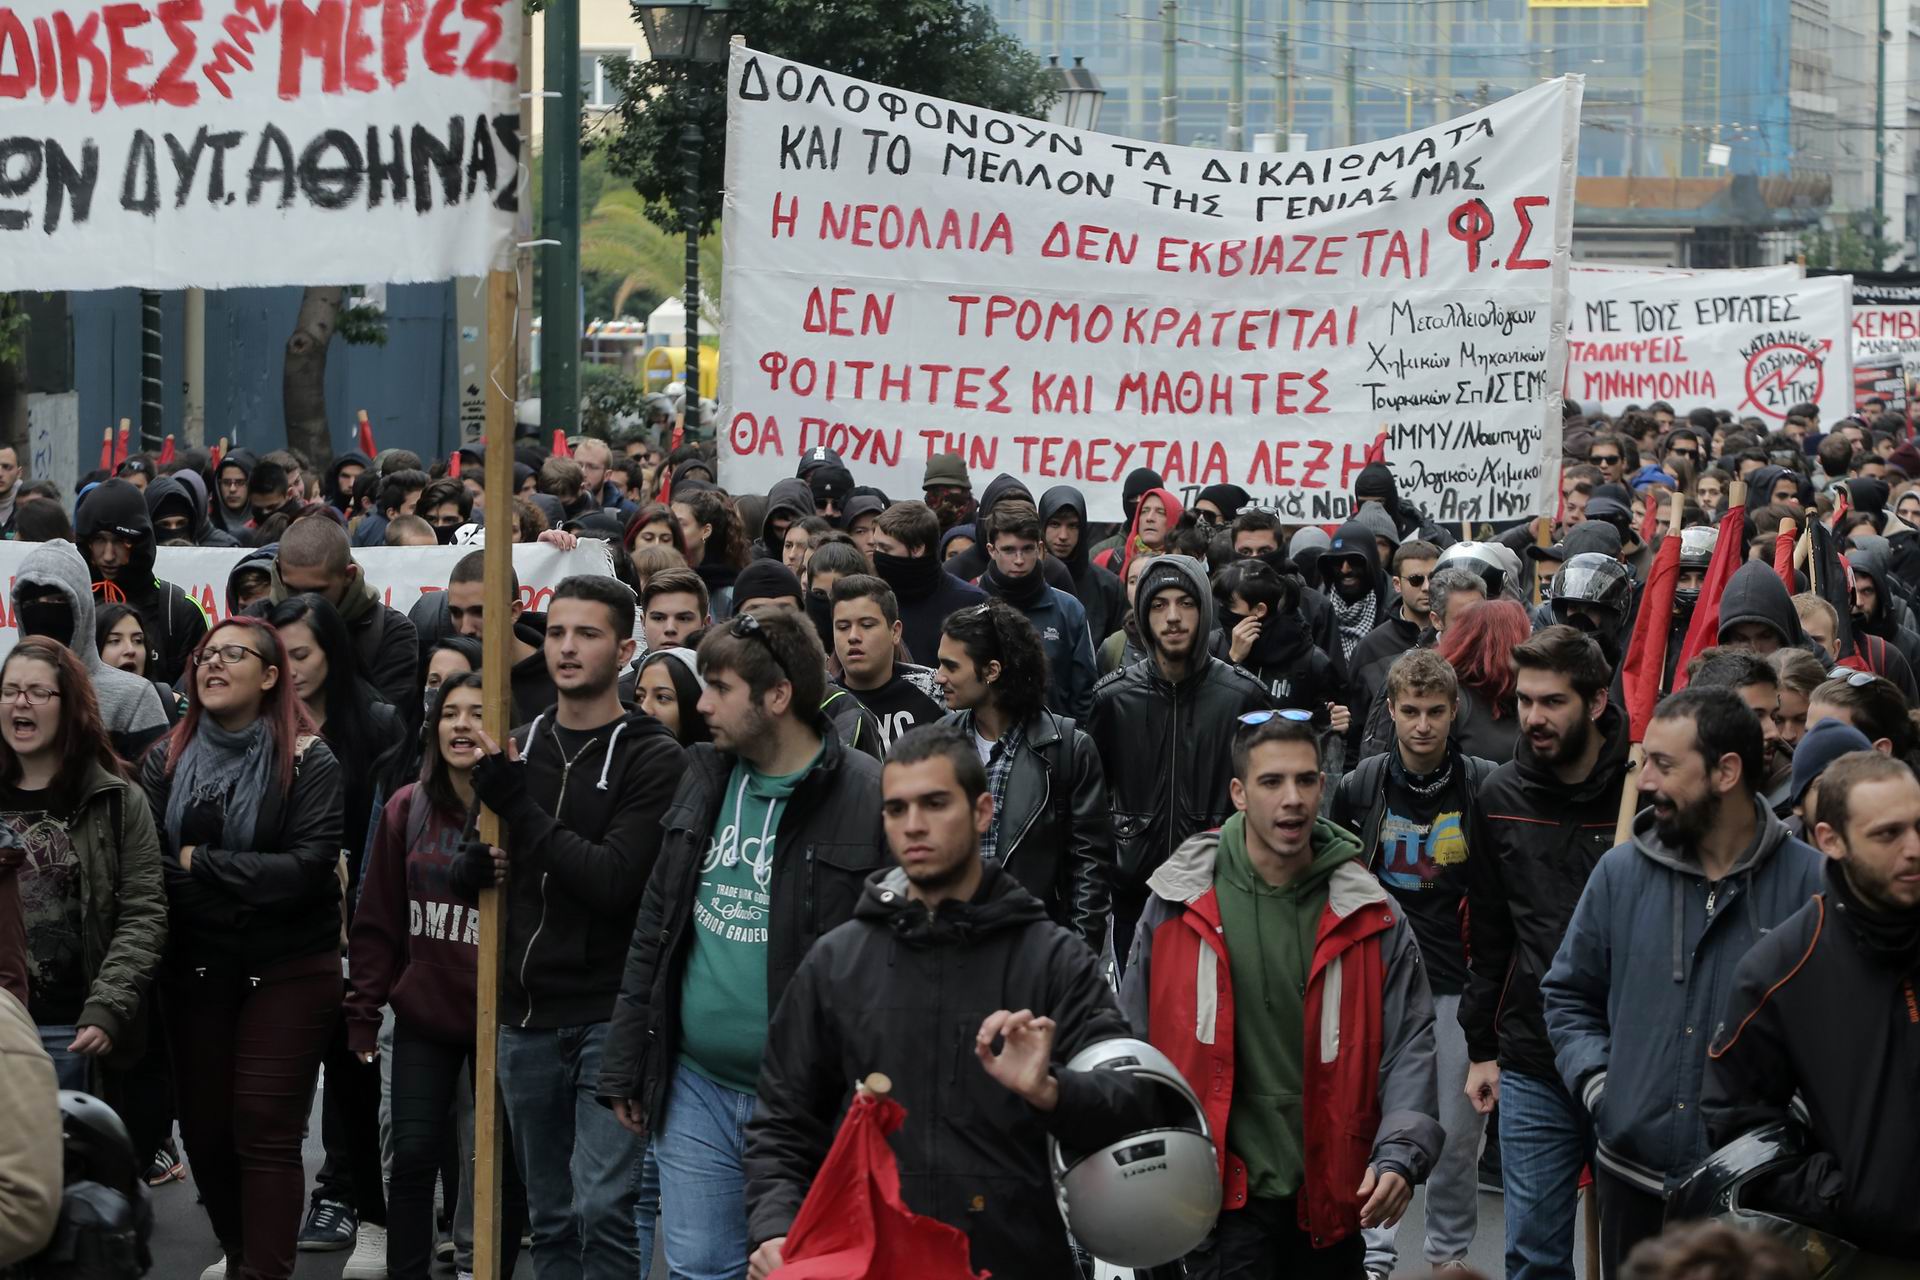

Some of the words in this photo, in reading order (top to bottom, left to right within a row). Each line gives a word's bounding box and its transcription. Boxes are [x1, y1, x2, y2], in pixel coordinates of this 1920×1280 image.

[739, 56, 1083, 156] ΔΟΛΟΦΟΝΟΥΝ
[1112, 143, 1171, 175] ΤΑ
[1201, 117, 1495, 187] ΔΙΚΑΙΩΜΑΤΑ
[780, 125, 842, 171] ΚΑΙ
[862, 128, 911, 175] ΤΟ
[942, 142, 1114, 198] ΜΕΛΛΟΝ
[1143, 181, 1224, 218] ΤΗΣ
[1256, 180, 1398, 222] ΓΕΝΙΑΣ
[1411, 156, 1485, 198] ΜΑΣ
[771, 191, 799, 239] Η
[819, 200, 1014, 255] ΝΕΟΛΑΙΑ
[1041, 221, 1138, 265] ΔΕΝ
[1156, 228, 1430, 279] ΕΚΒΙΑΖΕΤΑΙ
[802, 286, 896, 336] ΔΕΝ
[948, 294, 1359, 351] ΤΡΟΜΟΚΡΑΤΕΙΤΑΙ
[1586, 300, 1621, 332] ΜΕ
[1629, 300, 1682, 333] ΤΟΥΣ
[1695, 293, 1801, 325] ΕΡΓΑΤΕΣ
[1852, 311, 1920, 339] ΚΕΜΒ
[759, 351, 1012, 414] ΦΟΙΤΗΤΕΣ
[1032, 370, 1093, 415] ΚΑΙ
[1115, 368, 1331, 417] ΜΑΘΗΤΕΣ
[1583, 369, 1716, 402] ΜΝΗΜΟΝΙΑ
[729, 412, 783, 457] ΘΑ
[799, 417, 902, 466] ΠΟΥΝ
[919, 430, 998, 469] ΤΗΝ
[1013, 436, 1229, 486] ΤΕΛΕΥΤΑΙΑ
[716, 884, 738, 898] TRADE
[726, 924, 769, 943] GRADED
